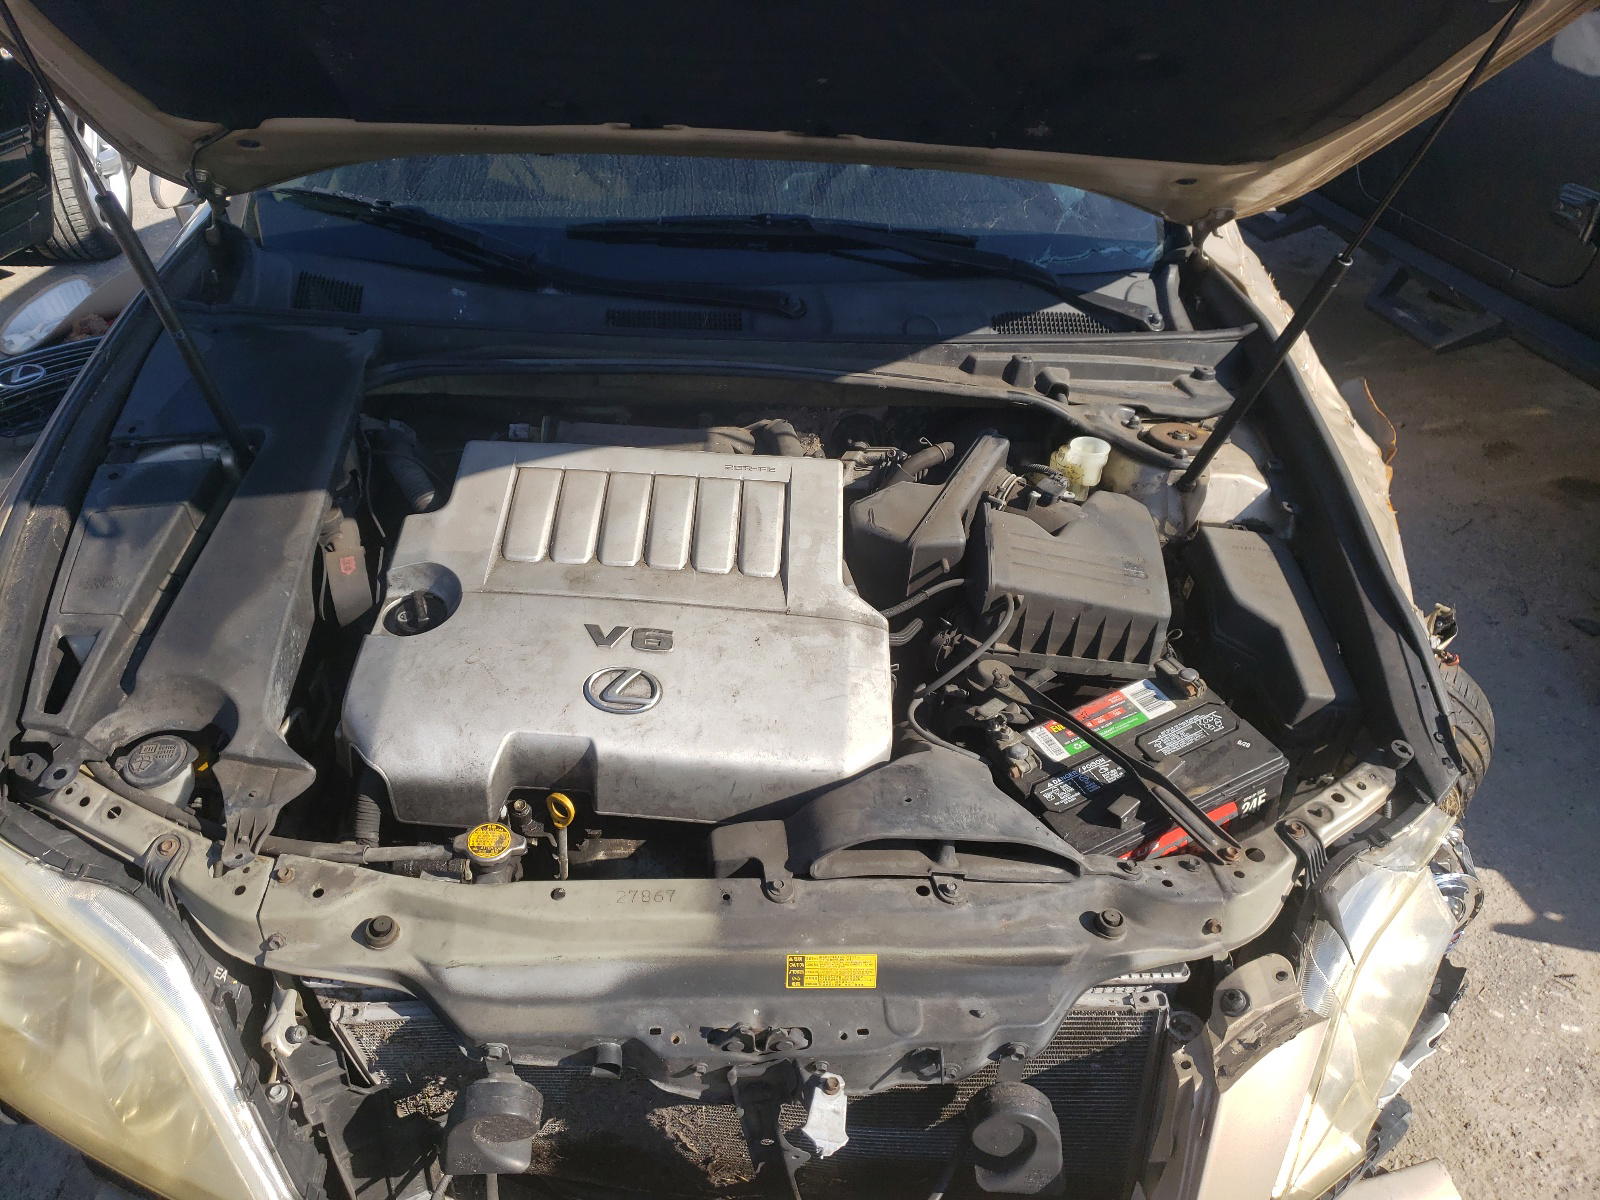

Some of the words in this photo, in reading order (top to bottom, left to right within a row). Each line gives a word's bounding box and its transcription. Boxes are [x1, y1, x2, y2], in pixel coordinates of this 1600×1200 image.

[583, 622, 674, 653] V6
[1082, 757, 1106, 770] POISON
[615, 889, 677, 904] 27867
[213, 966, 228, 983] EA
